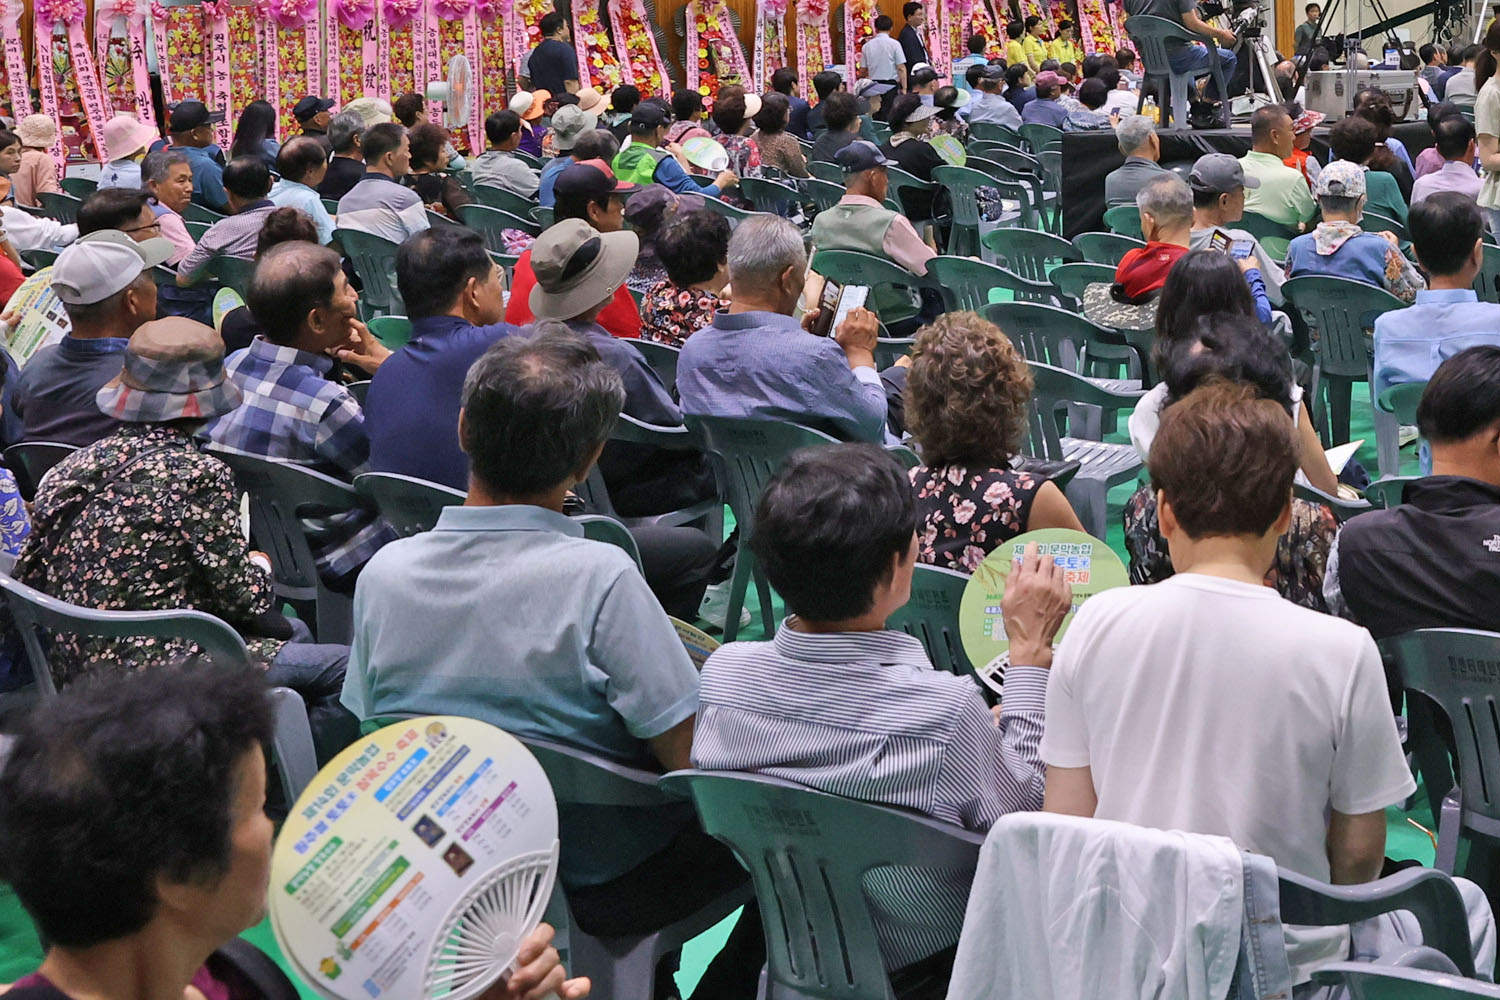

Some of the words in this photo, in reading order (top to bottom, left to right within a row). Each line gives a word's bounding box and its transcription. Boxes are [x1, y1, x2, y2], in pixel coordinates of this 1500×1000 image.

[328, 16, 338, 63] 농협경제지주
[364, 20, 376, 42] 祝
[930, 19, 937, 39] 축
[132, 36, 142, 66] 축
[156, 34, 166, 74] NH농협
[214, 33, 226, 64] 원주시
[40, 44, 54, 104] NH농협생명
[1014, 544, 1047, 556] 제회
[1049, 544, 1092, 556] 문막농협
[1064, 571, 1090, 584] 축제
